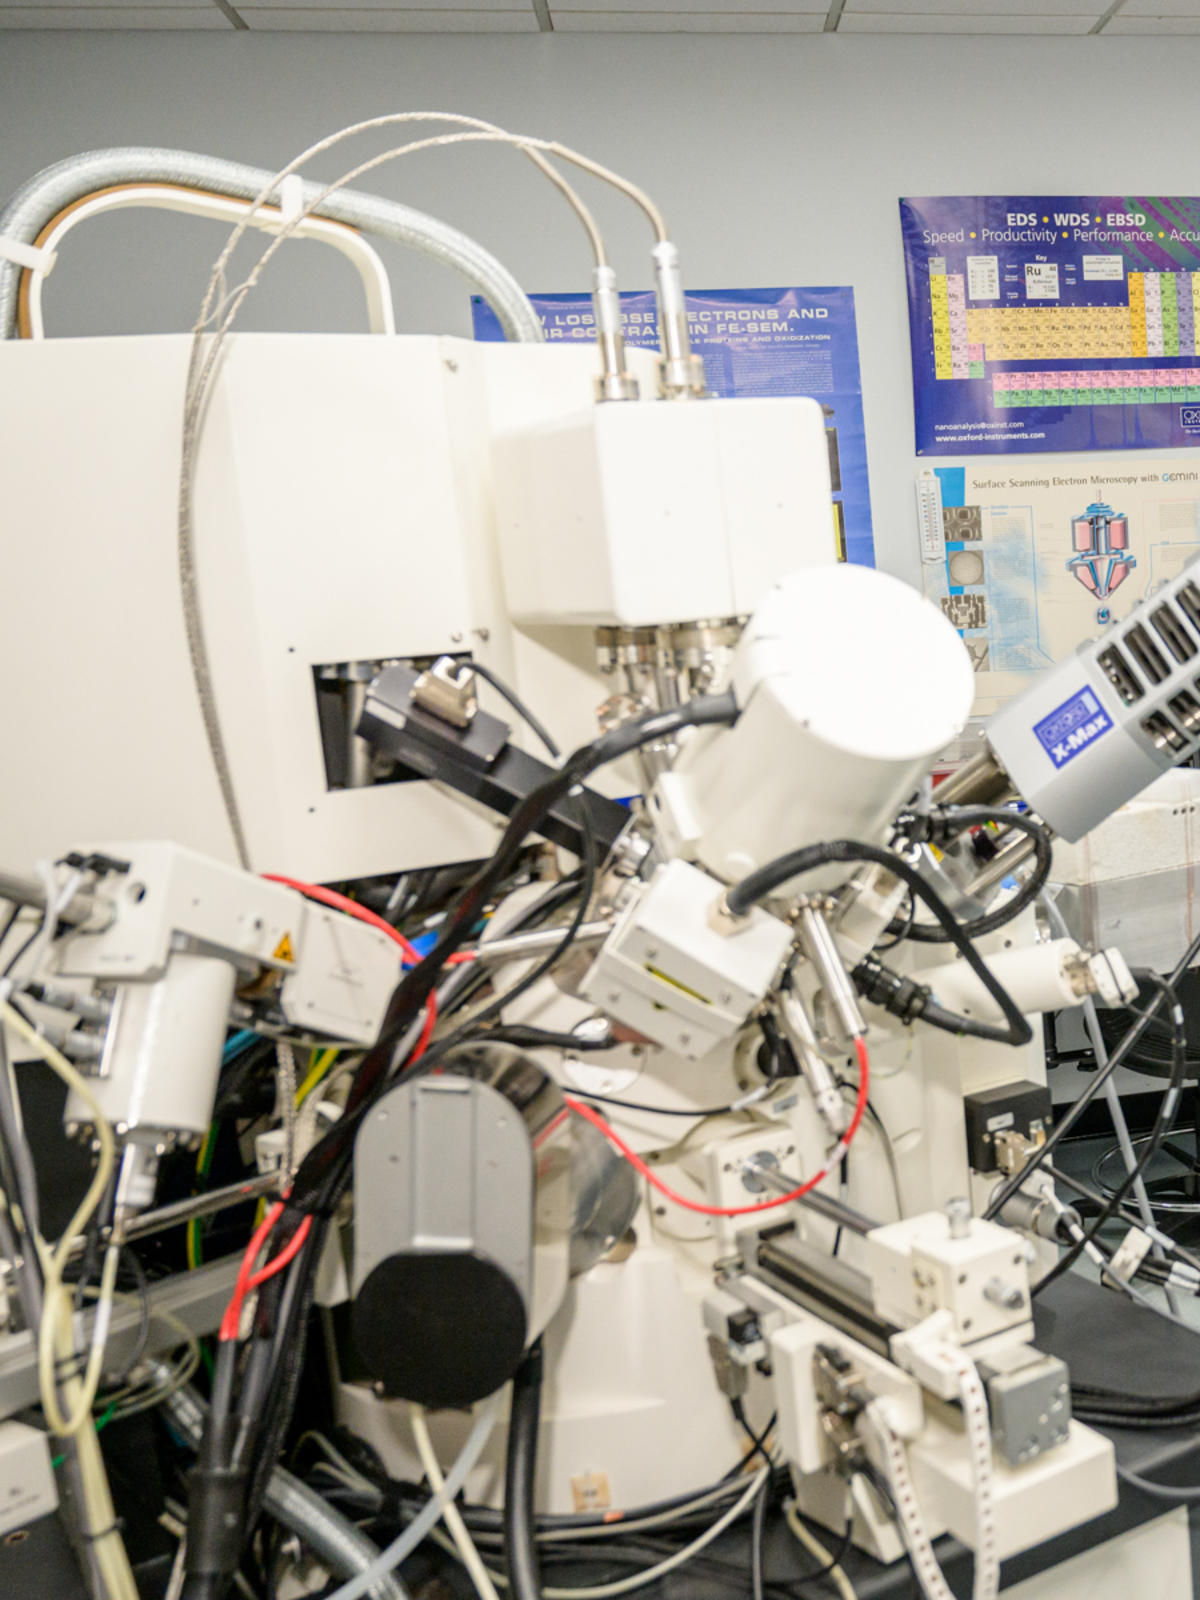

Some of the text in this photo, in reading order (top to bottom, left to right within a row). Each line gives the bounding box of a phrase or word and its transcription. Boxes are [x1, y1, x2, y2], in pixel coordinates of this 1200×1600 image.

[1007, 213, 1146, 226] EDS WDS EBSD
[923, 228, 964, 246] Speed
[982, 228, 1057, 245] Productivity
[1073, 228, 1153, 242] Performance
[1035, 254, 1047, 262] Key
[1026, 265, 1041, 276] Ru
[555, 314, 595, 326] LOS
[687, 309, 779, 322] ECTRONS
[787, 308, 829, 319] AND
[935, 432, 1046, 442] www.oxford-instruments.com
[972, 479, 1006, 489] Surface
[1008, 478, 1050, 489] Scanning
[1052, 476, 1087, 486] Electron
[1090, 475, 1137, 485] Microscopy
[1140, 473, 1159, 483] with
[1052, 714, 1108, 762] X-Max
